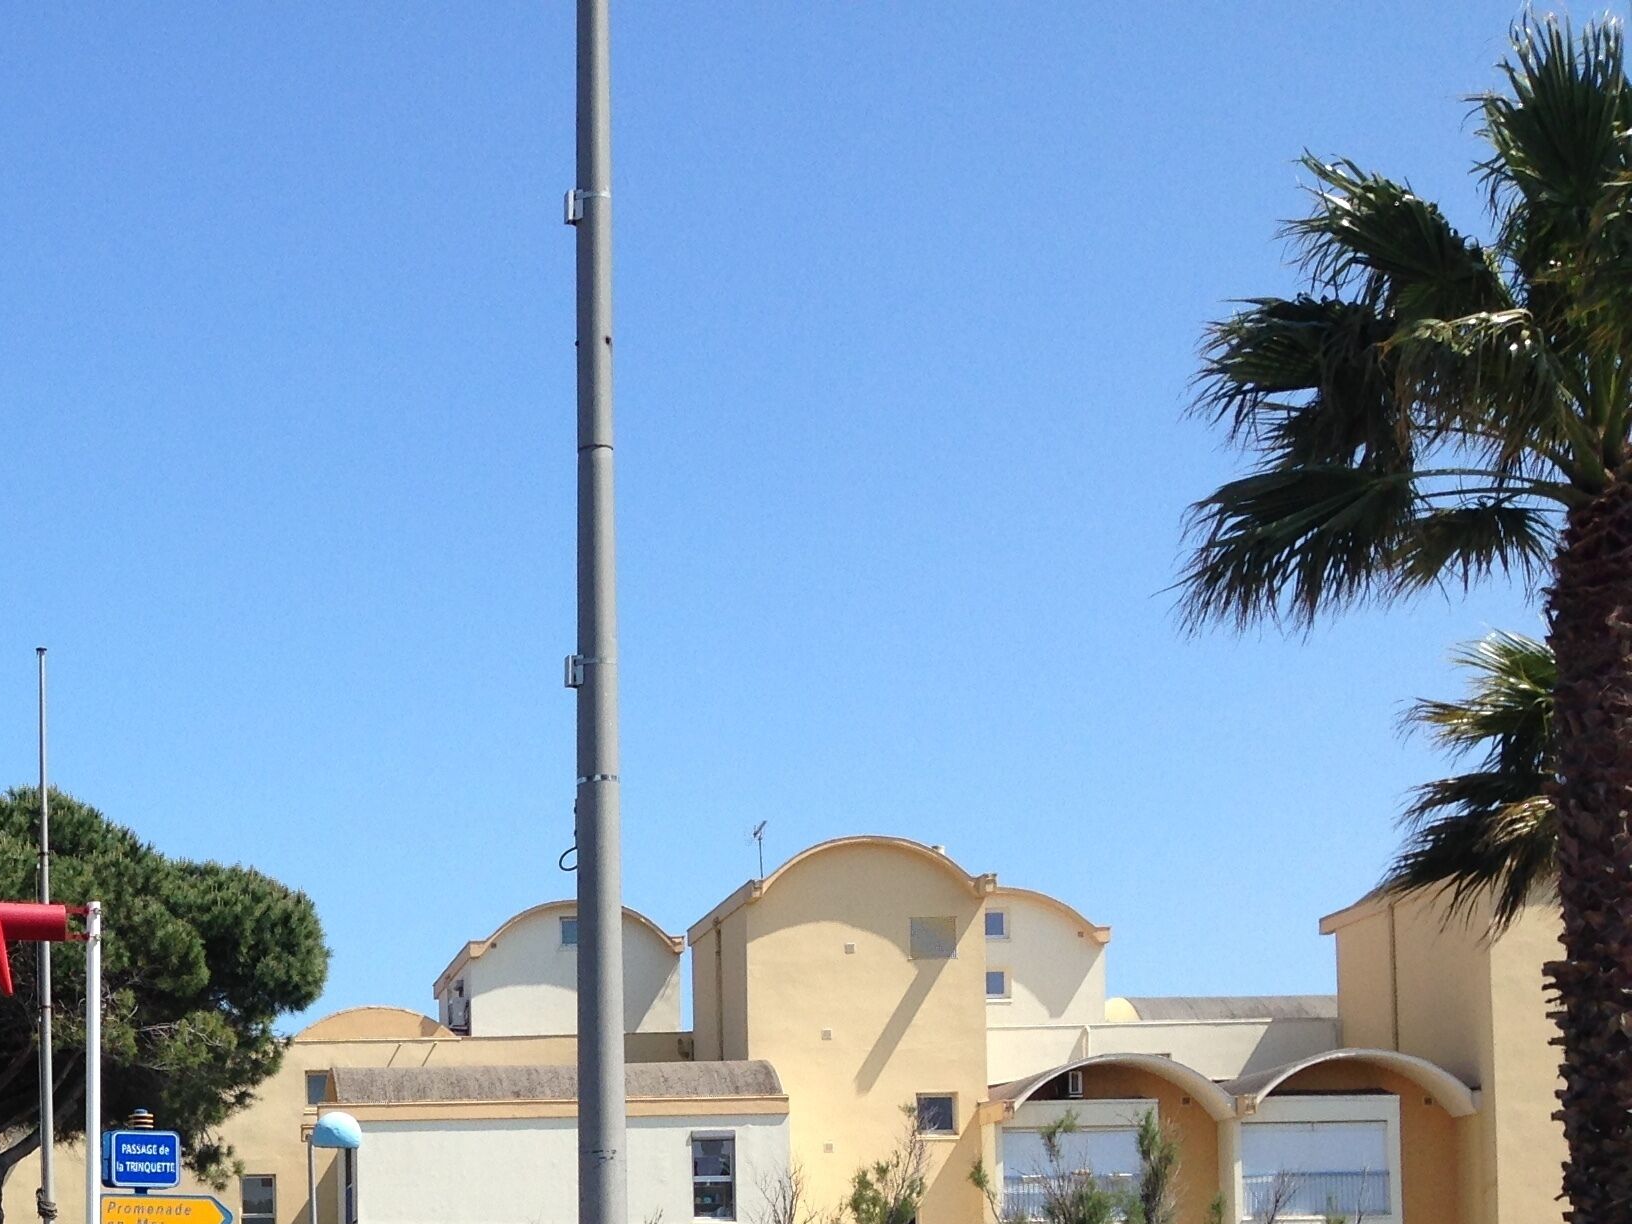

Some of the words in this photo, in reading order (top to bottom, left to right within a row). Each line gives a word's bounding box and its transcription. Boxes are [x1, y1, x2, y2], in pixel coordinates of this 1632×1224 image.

[121, 1143, 157, 1155] PASSAGE
[158, 1144, 170, 1156] de
[116, 1161, 124, 1172] la
[125, 1161, 176, 1174] TRINQUETTE
[107, 1201, 192, 1216] Promenade
